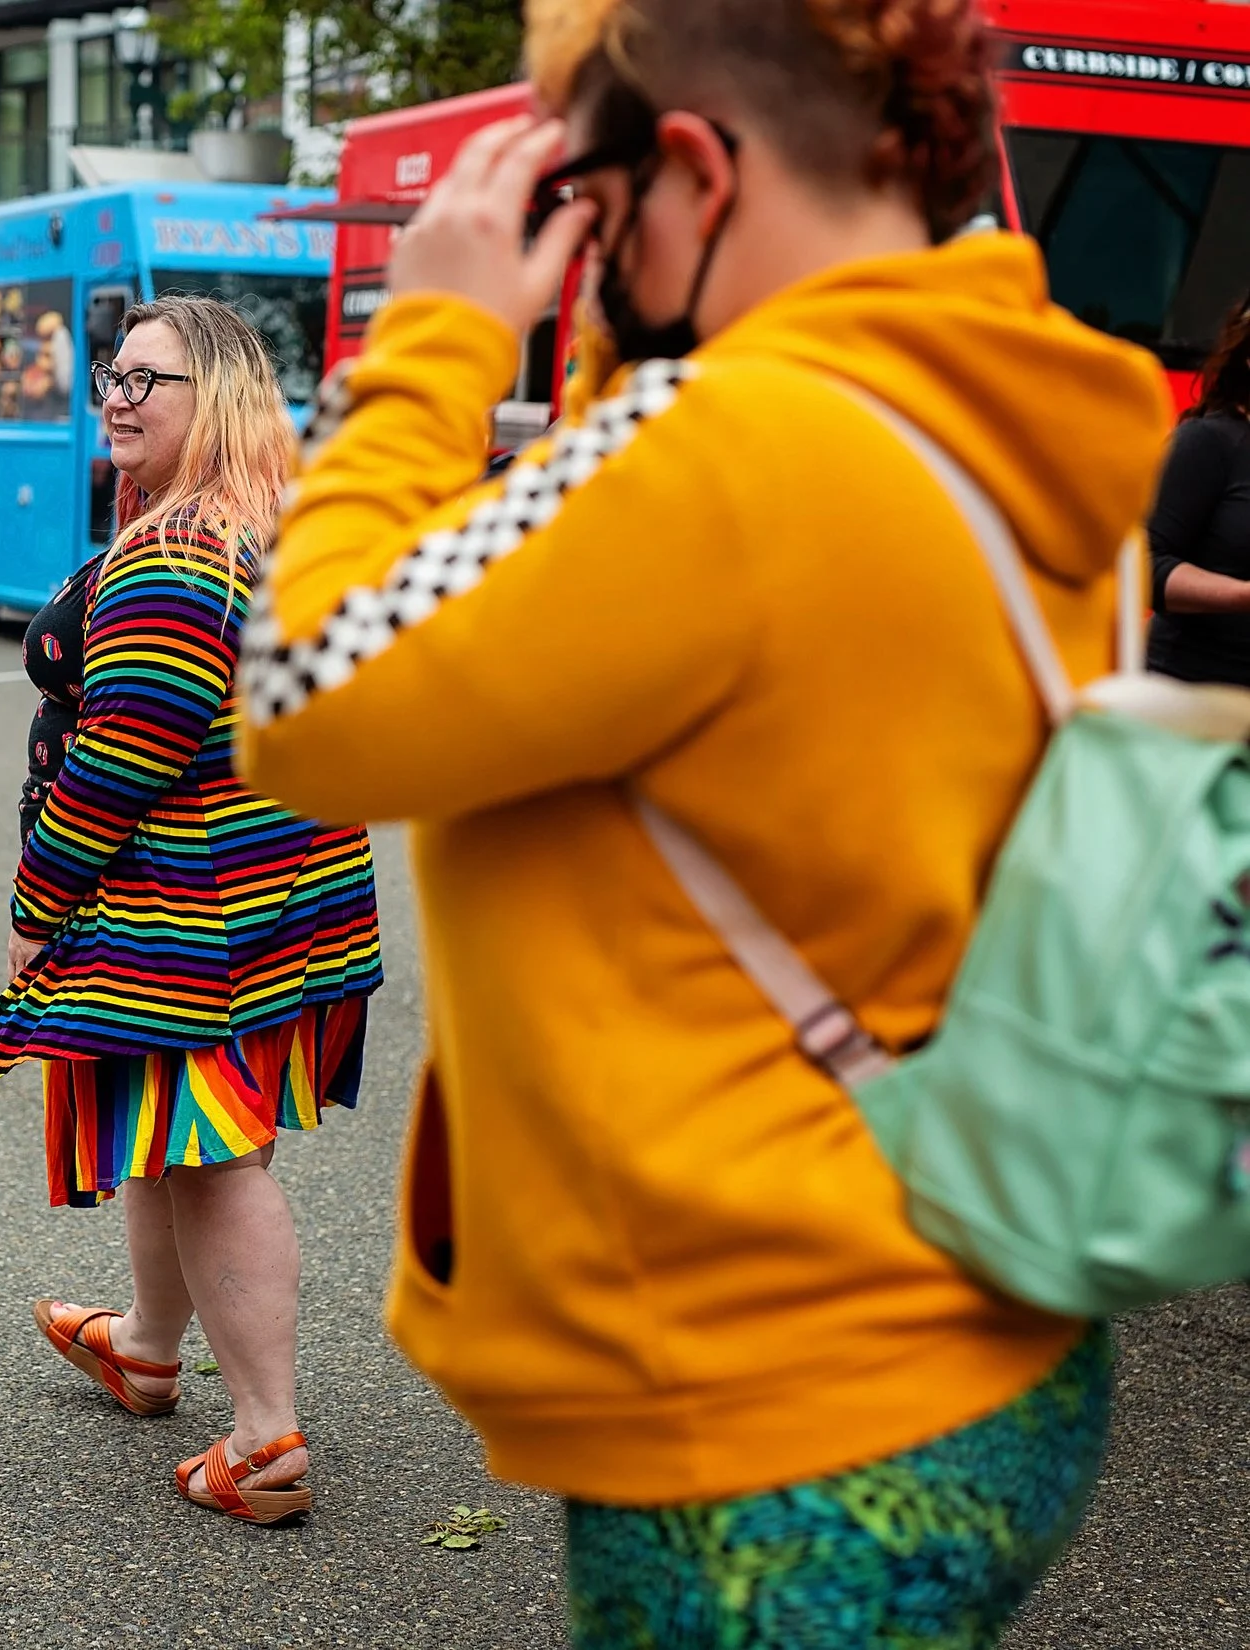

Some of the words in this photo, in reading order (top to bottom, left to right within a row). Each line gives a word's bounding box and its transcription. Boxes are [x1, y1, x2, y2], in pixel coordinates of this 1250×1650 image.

[1022, 46, 1179, 81] CURBSIDE
[1202, 62, 1250, 87] CO
[154, 219, 300, 258] RYAN'S
